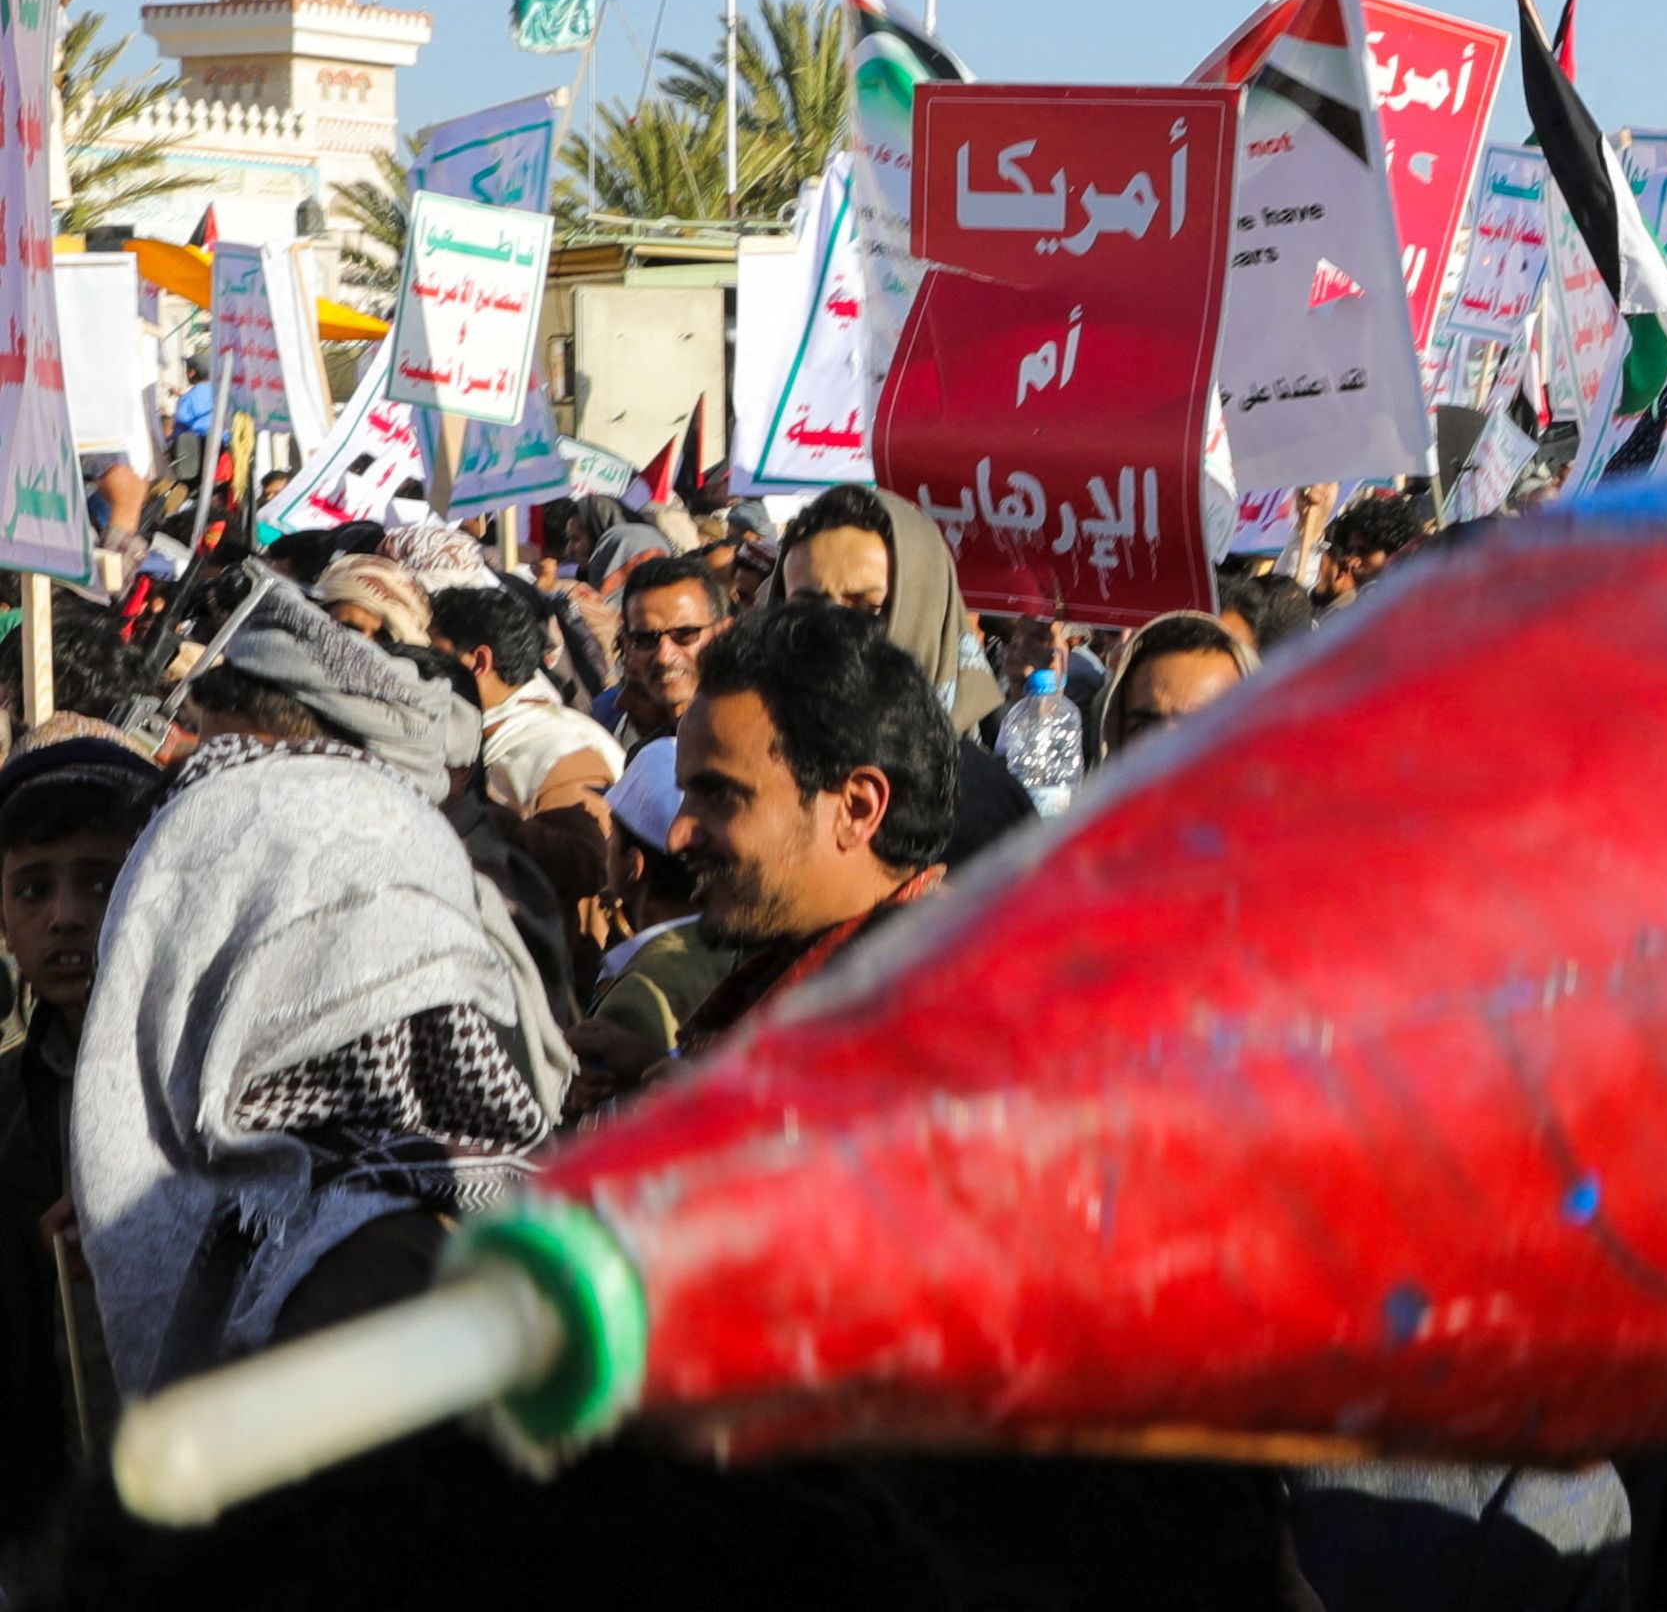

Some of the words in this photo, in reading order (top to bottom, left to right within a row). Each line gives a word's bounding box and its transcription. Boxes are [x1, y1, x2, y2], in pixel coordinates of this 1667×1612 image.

[956, 116, 1188, 256] أمريكا
[1237, 215, 1257, 230] e
[1261, 202, 1325, 227] have
[1233, 246, 1280, 268] ars
[1016, 304, 1083, 409] أم
[917, 455, 1159, 570] الإرهاب
